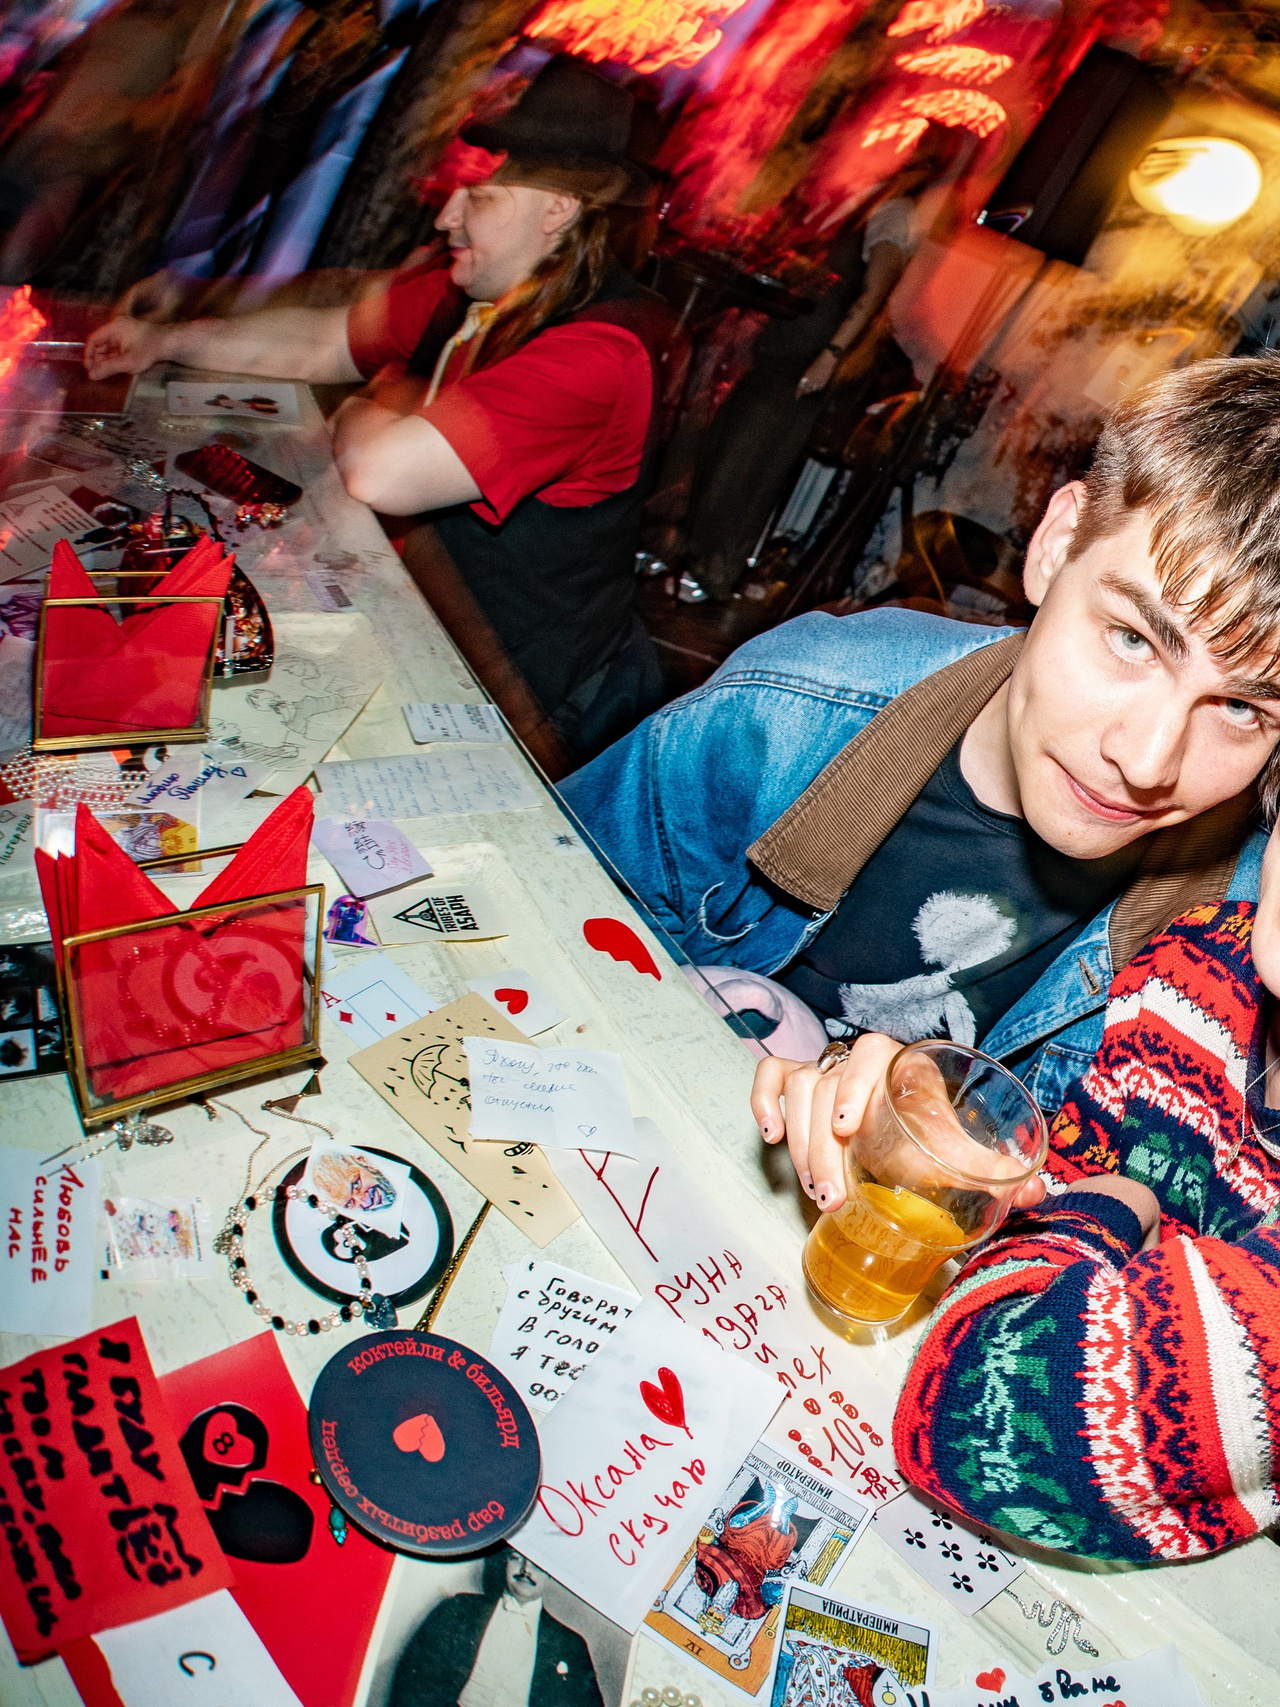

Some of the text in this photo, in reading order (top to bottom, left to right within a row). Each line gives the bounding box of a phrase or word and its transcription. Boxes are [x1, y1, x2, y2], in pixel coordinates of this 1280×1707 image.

[431, 896, 460, 934] TRIBES OF
[446, 894, 480, 931] ASAPH
[347, 1336, 521, 1450] коктейли & бильярд
[321, 1418, 506, 1544] бар разбитых сердец
[537, 1433, 674, 1537] Оксана
[608, 1458, 706, 1567] скучаю
[776, 1459, 834, 1499] ИМПЕРАТОР
[821, 1598, 900, 1637] ИМПЕРАТРИЦА
